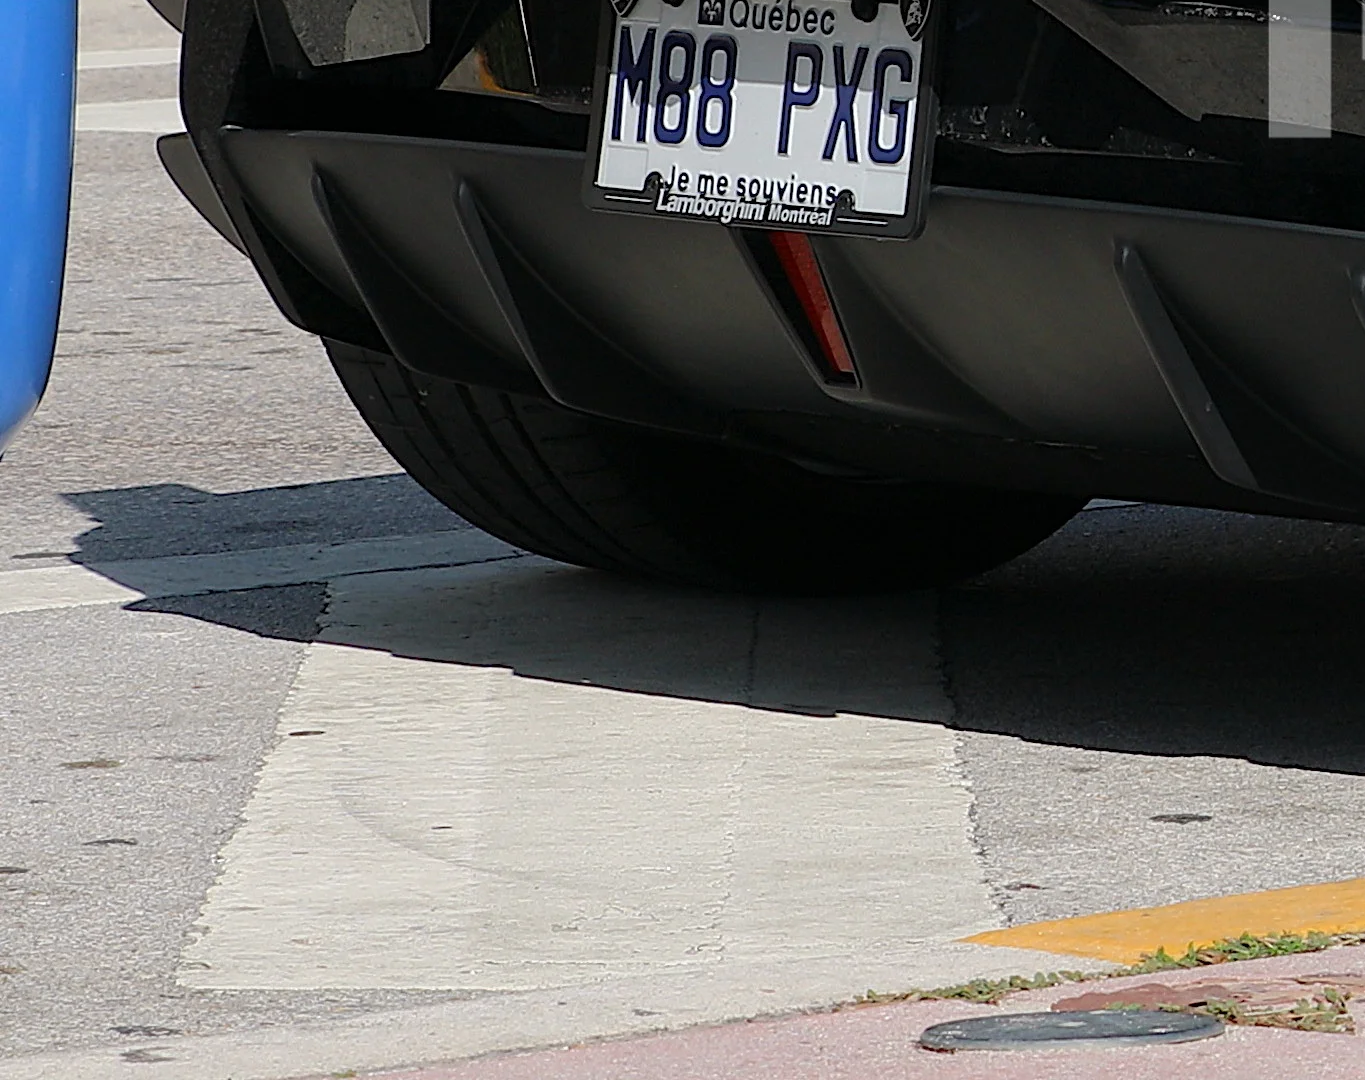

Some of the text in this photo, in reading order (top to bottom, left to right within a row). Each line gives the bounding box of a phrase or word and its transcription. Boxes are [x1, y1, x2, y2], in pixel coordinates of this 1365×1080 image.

[611, 26, 913, 164] M88 PXG
[665, 166, 837, 205] Je me souviens
[656, 189, 832, 225] Lamborghini Montréal
